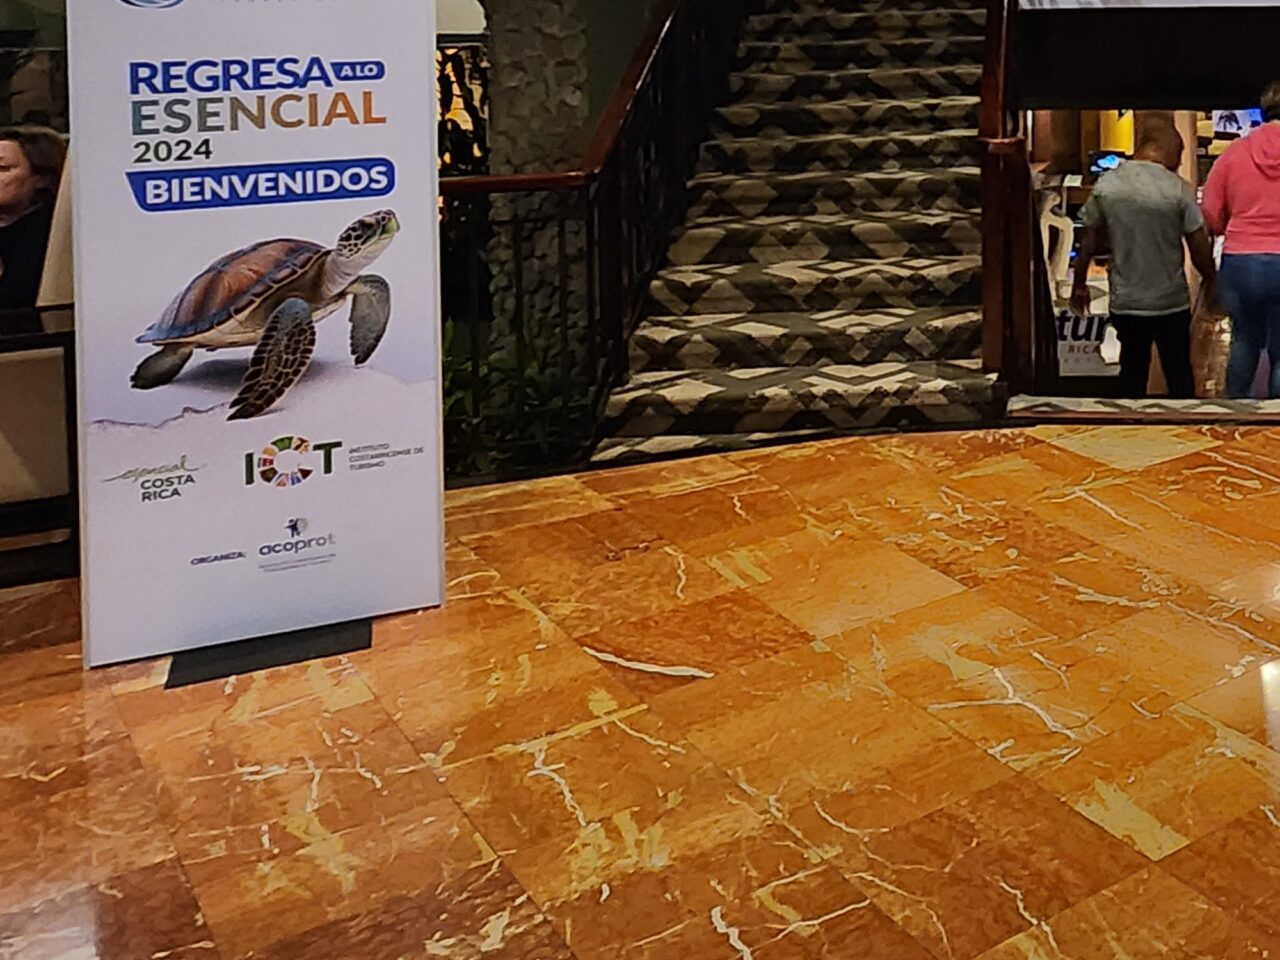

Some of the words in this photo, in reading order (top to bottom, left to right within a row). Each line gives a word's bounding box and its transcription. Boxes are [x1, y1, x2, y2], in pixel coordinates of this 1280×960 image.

[129, 57, 333, 94] REGRESA
[340, 64, 353, 77] A
[357, 63, 378, 77] LO
[131, 91, 387, 135] ESENCIAL
[133, 138, 213, 163] 2024
[145, 166, 390, 205] BIENVENIDOS
[244, 435, 343, 487] ICT
[140, 474, 196, 490] COSTA
[141, 487, 182, 502] RICA
[258, 533, 337, 556] acoprot
